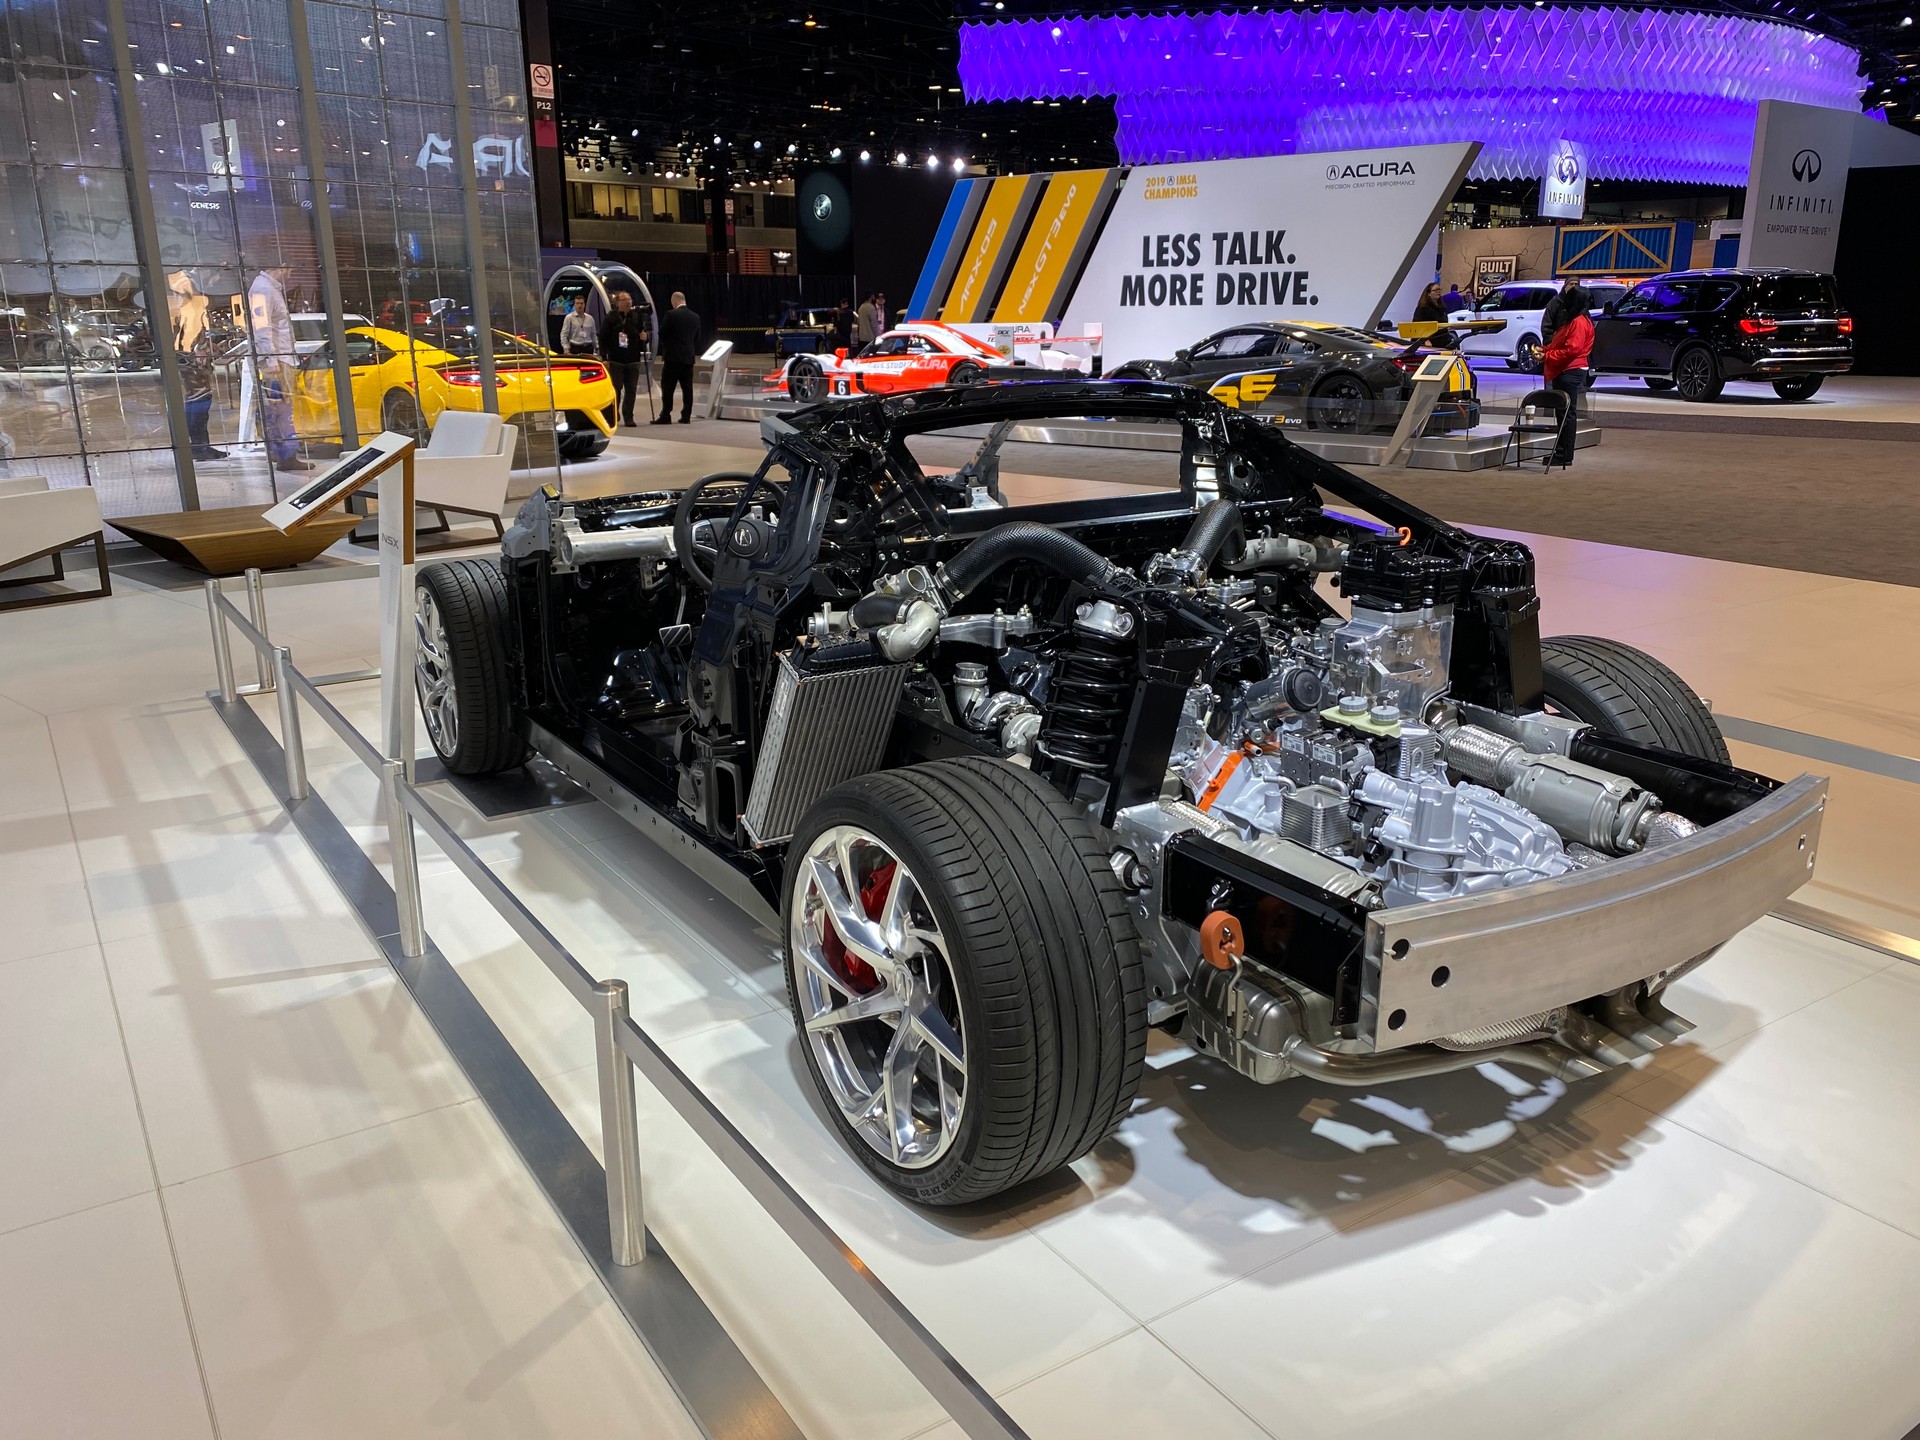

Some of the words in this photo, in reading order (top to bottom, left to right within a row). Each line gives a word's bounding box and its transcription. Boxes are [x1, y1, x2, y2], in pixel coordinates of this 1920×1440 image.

[536, 101, 552, 110] P12
[1340, 161, 1415, 179] ACURA
[1145, 176, 1166, 188] 2019
[1176, 174, 1197, 185] IMSA
[1376, 179, 1416, 187] PERFORMANCE
[1144, 186, 1199, 200] CHAMPIONS
[1548, 191, 1583, 206] INFINITI
[190, 201, 220, 210] GENESIS
[1766, 223, 1798, 235] EMPOWER
[1799, 225, 1810, 235] THE
[1142, 232, 1201, 268] LESS
[1212, 229, 1297, 266] TALK.
[960, 217, 998, 315] ARX-05
[1480, 261, 1512, 273] BUILT
[1119, 273, 1204, 307] MORE
[1215, 271, 1319, 306] DRIVE.
[837, 380, 847, 395] 6
[381, 533, 400, 549] NSX
[941, 1164, 965, 1190] 305/30
[920, 1189, 932, 1197] 20
